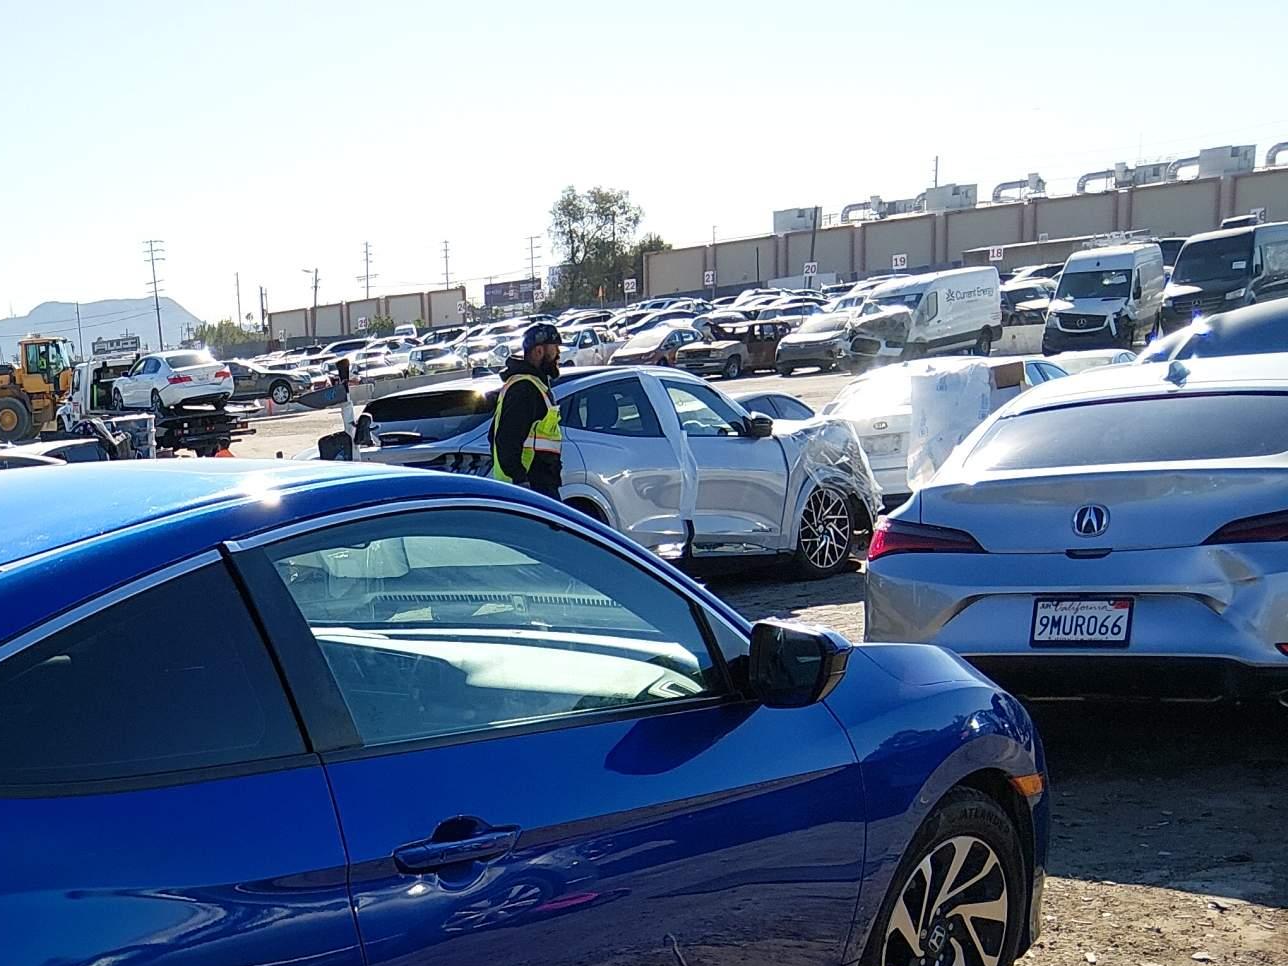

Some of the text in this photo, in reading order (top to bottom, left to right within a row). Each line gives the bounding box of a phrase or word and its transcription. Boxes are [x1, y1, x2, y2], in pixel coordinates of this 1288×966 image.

[990, 248, 1002, 258] 18
[893, 257, 905, 267] 19
[805, 264, 817, 274] 20
[625, 281, 636, 290] 22
[534, 291, 545, 300] 23
[955, 289, 977, 301] Current
[1055, 602, 1112, 614] California
[1037, 614, 1124, 636] 9MUR066
